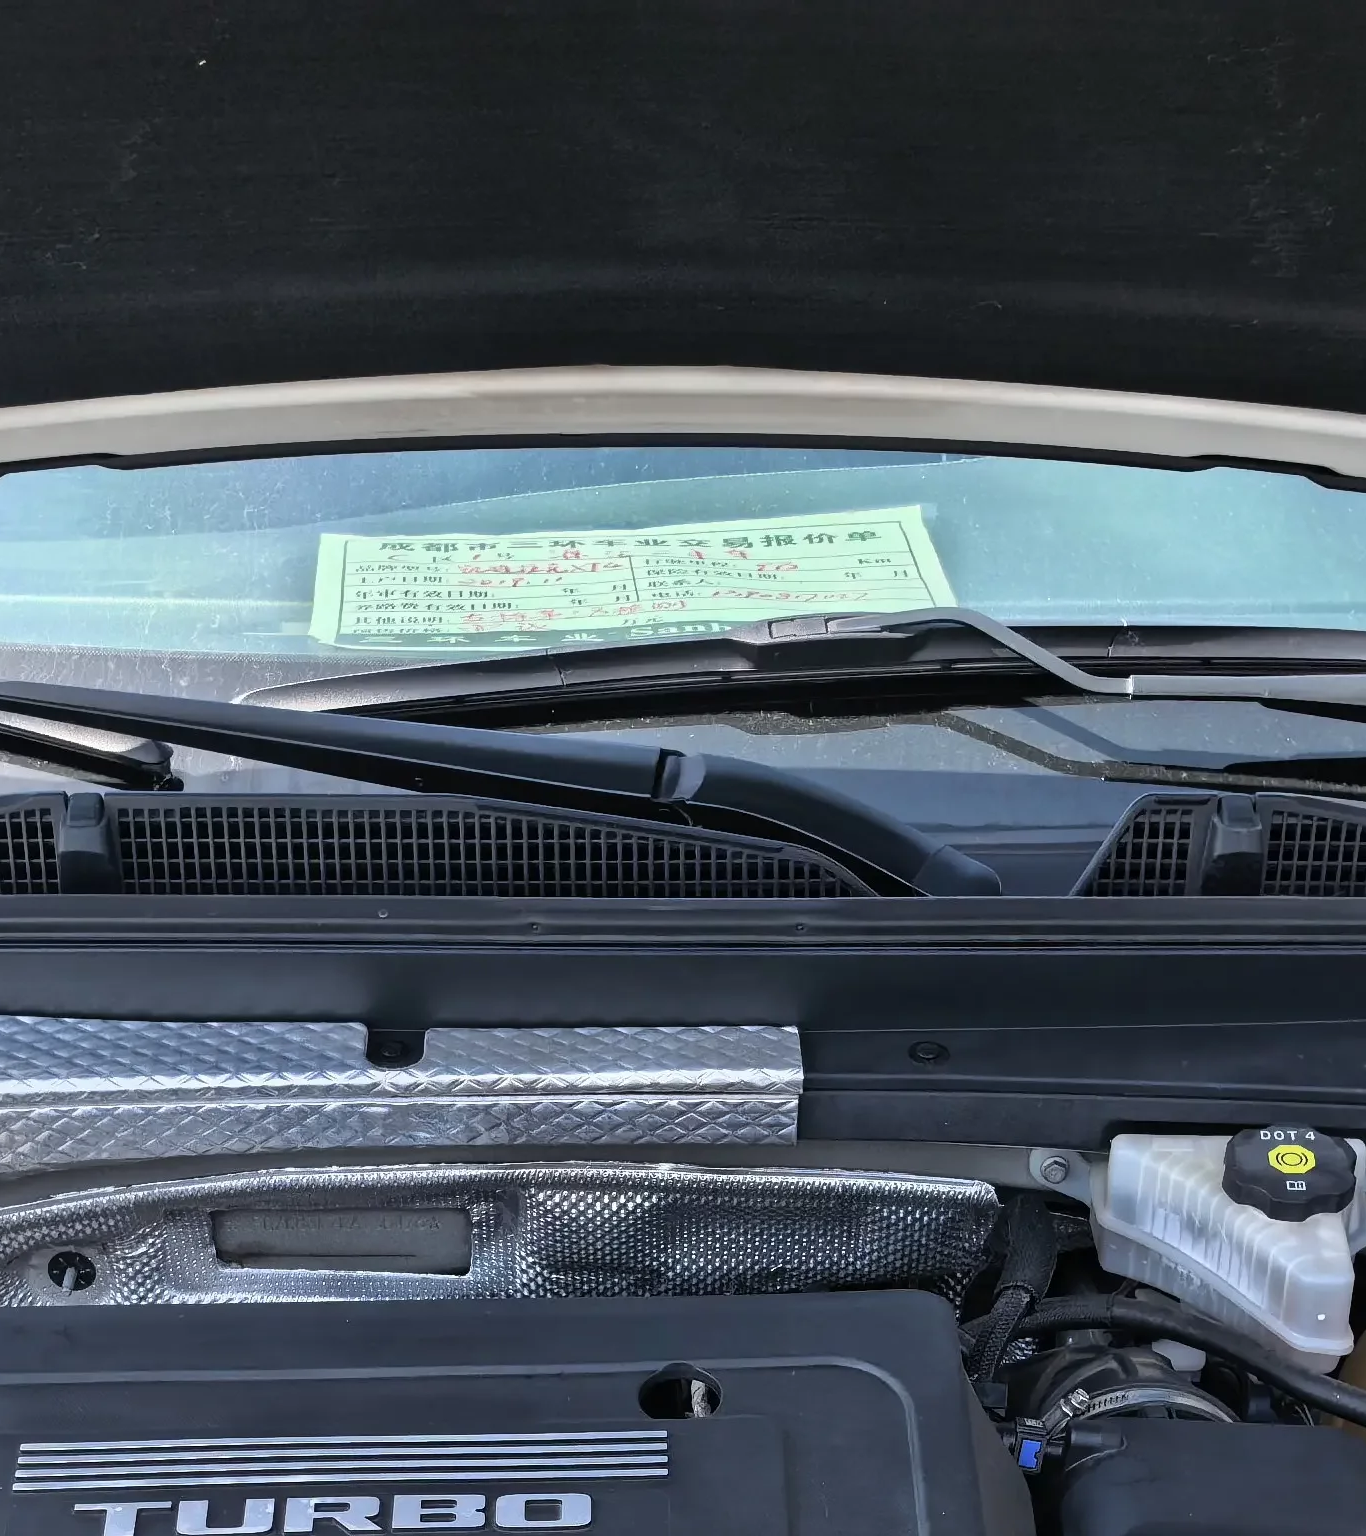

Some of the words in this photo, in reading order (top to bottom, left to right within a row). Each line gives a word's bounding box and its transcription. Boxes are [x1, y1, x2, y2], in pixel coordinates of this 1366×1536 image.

[379, 531, 882, 553] 成都市三环车业交易报价单
[359, 632, 605, 645] 三环车业
[1260, 1130, 1298, 1141] DOT
[1305, 1130, 1316, 1141] 4
